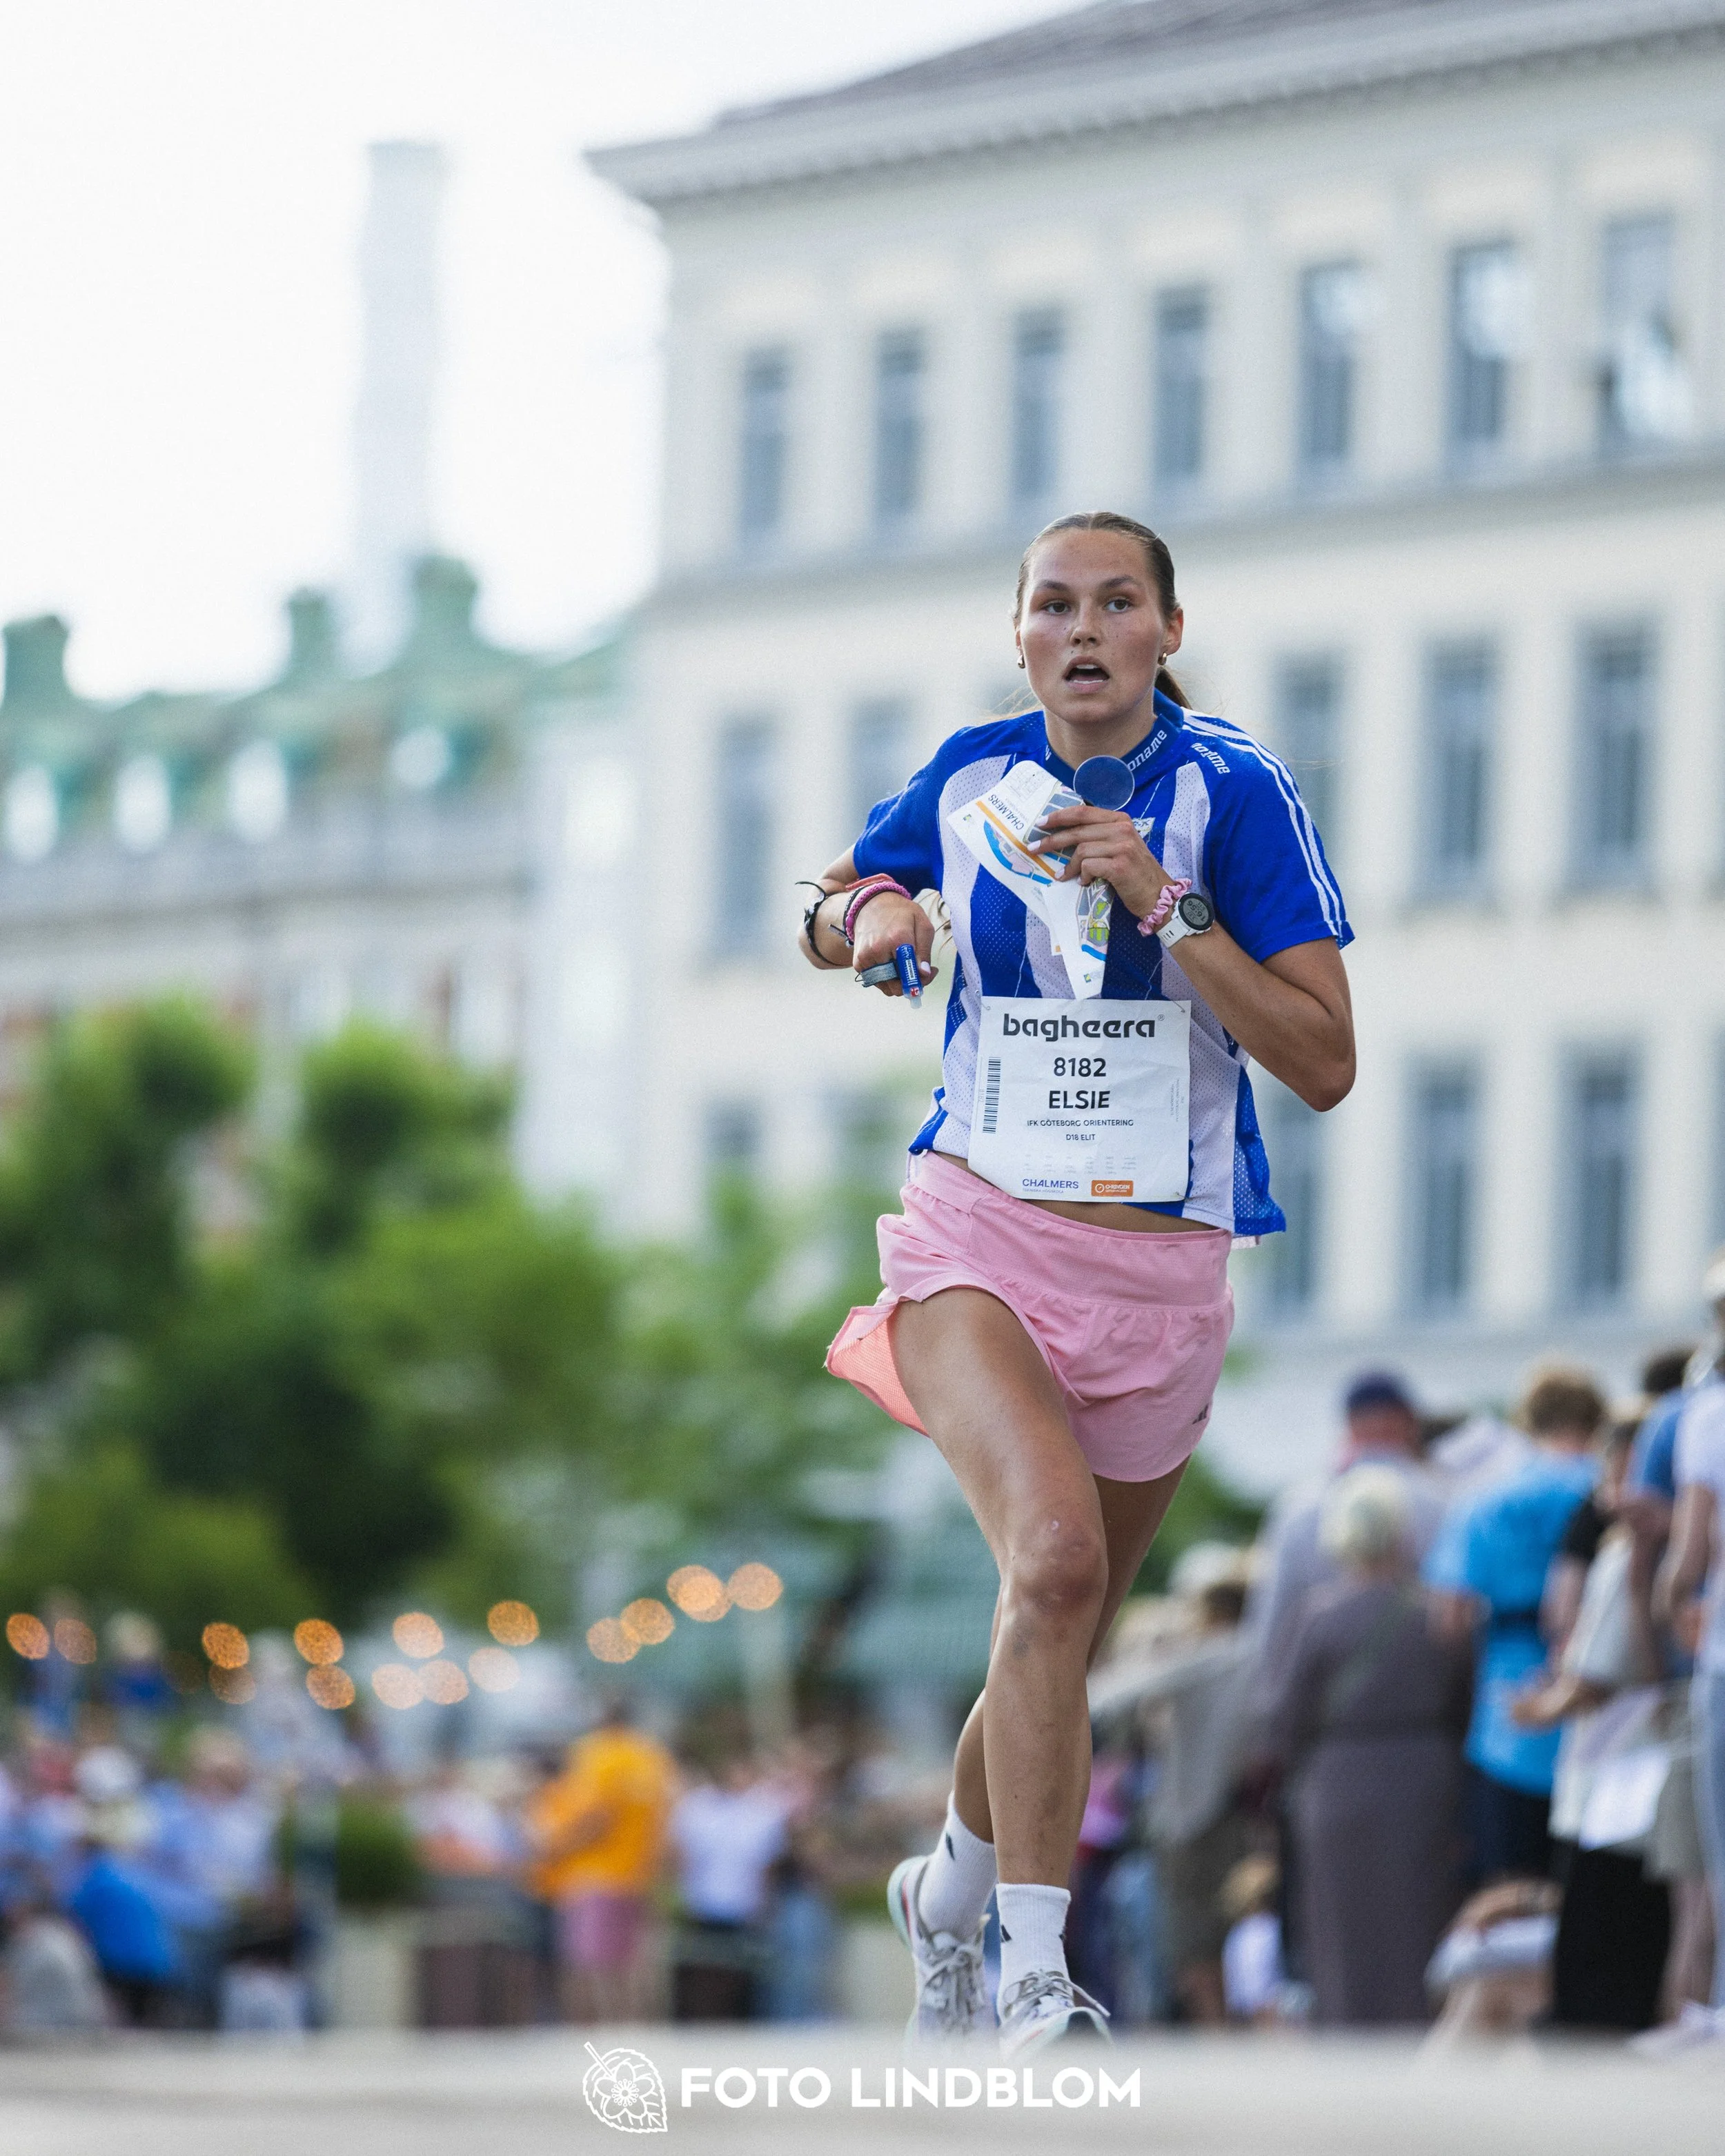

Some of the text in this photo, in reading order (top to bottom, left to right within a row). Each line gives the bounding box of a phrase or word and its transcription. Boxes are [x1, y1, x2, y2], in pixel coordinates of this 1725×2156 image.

[1127, 730, 1167, 771] oname
[988, 794, 1025, 830] CHALMERS
[1187, 900, 1206, 922] 16:56
[1003, 1013, 1155, 1042] bagheera
[1054, 1057, 1106, 1077] 8182
[1049, 1090, 1110, 1109] ELSIE
[1040, 1118, 1081, 1127] GÖTEBORG
[1022, 1178, 1079, 1189] CHALMERS
